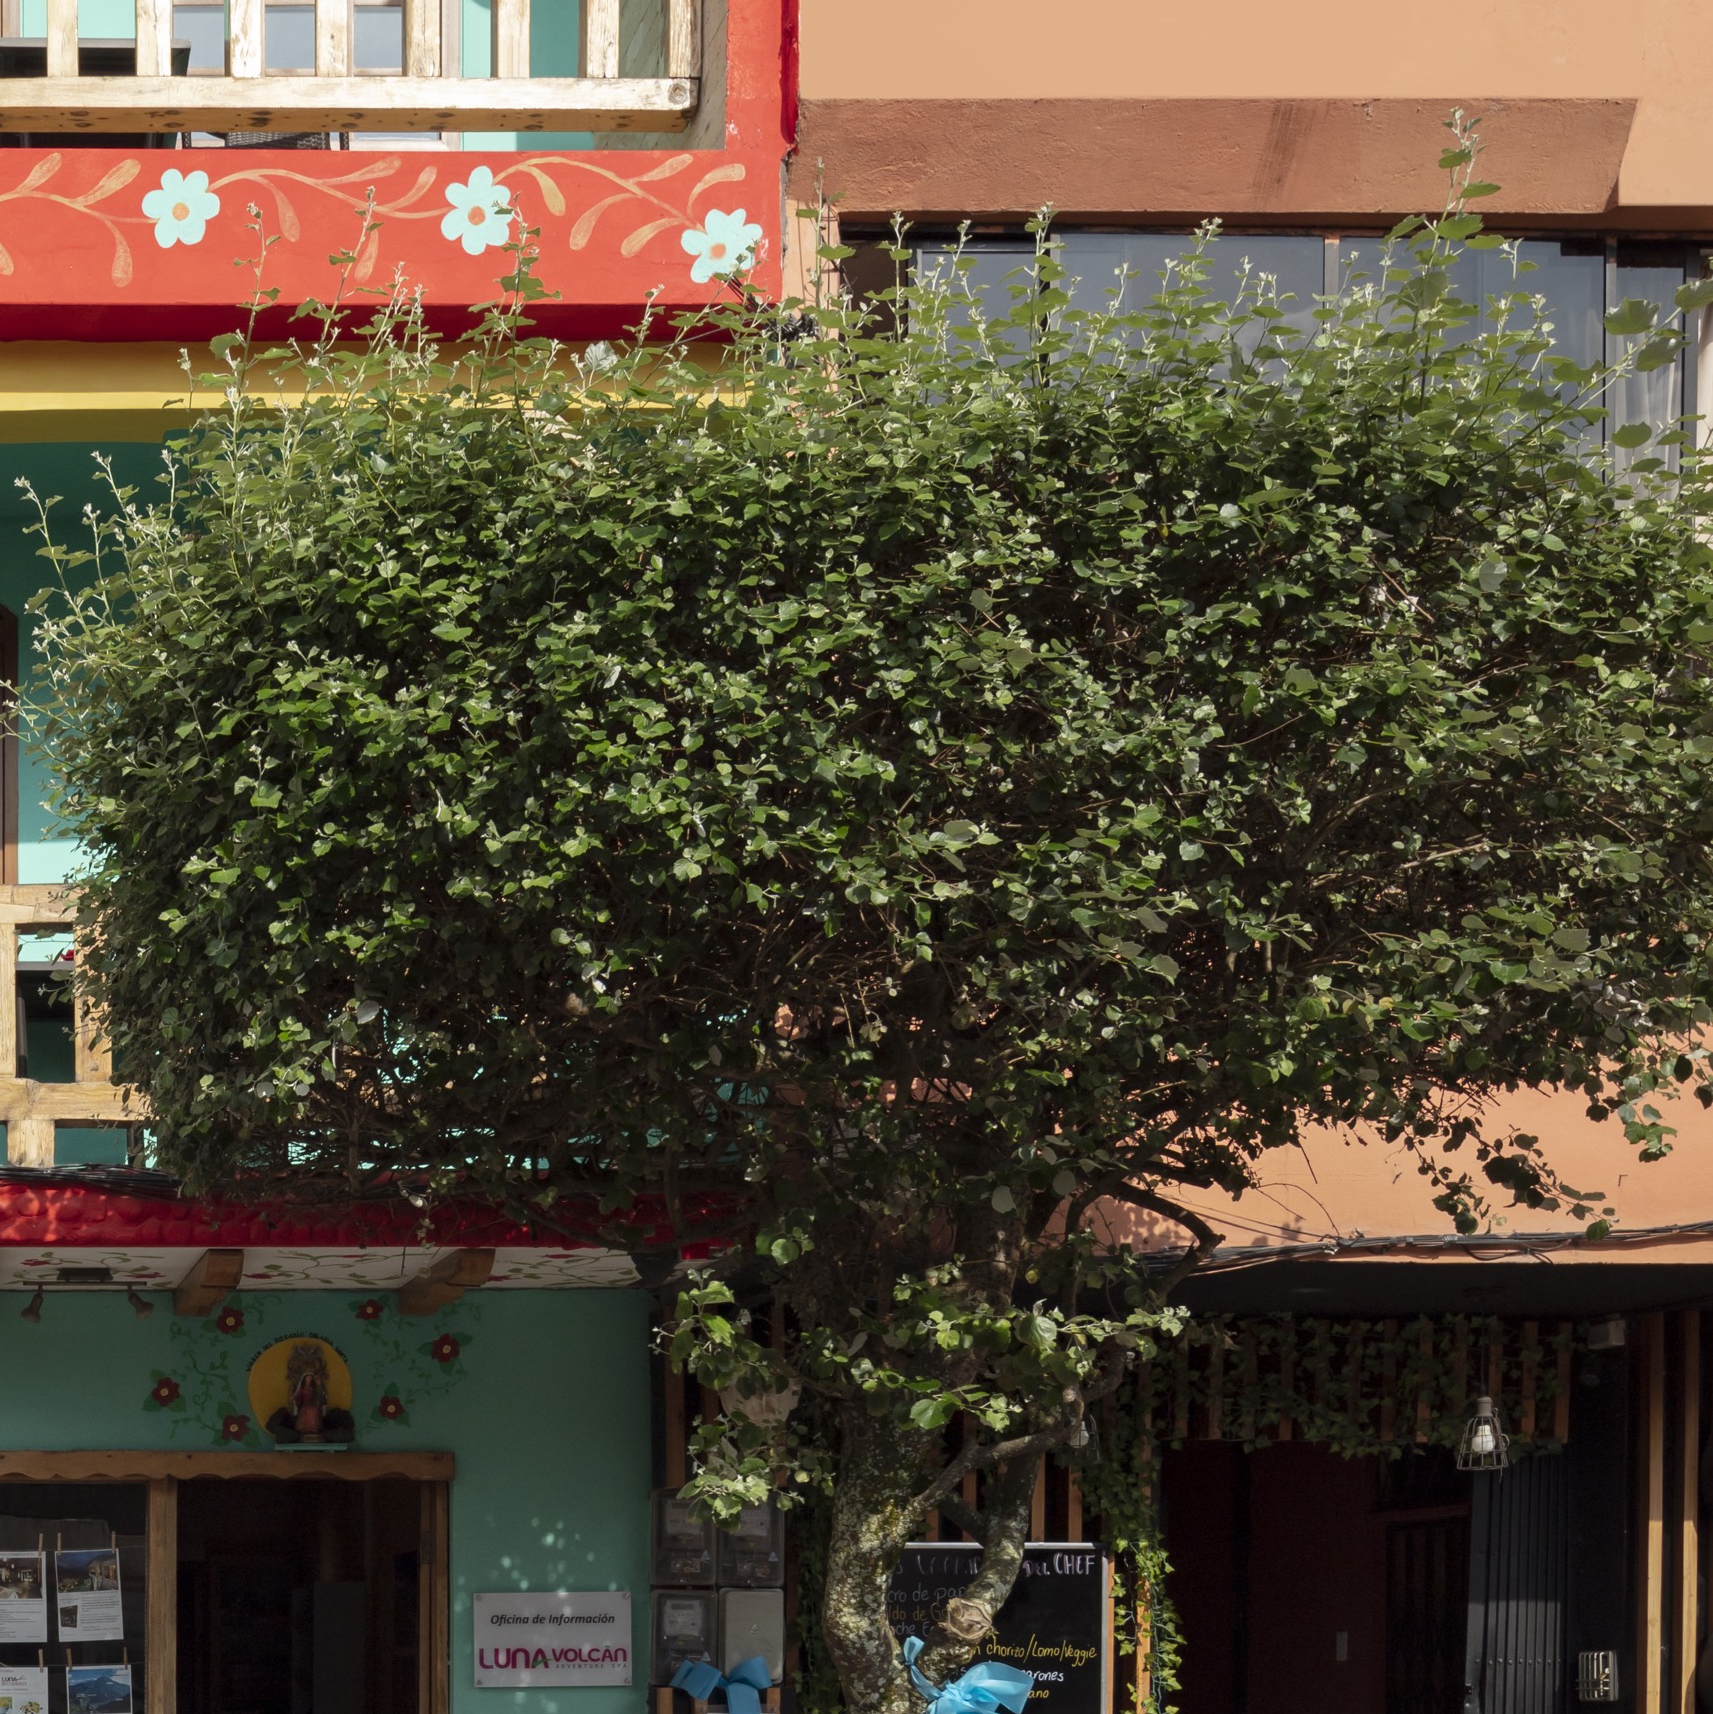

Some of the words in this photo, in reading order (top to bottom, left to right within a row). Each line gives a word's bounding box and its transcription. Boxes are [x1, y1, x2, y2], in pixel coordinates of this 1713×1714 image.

[1052, 1552, 1095, 1575] CHEF
[912, 1583, 930, 1601] de
[490, 1614, 529, 1627] Oficina
[532, 1614, 546, 1624] de
[548, 1613, 615, 1626] Información
[478, 1647, 550, 1669] LUNA
